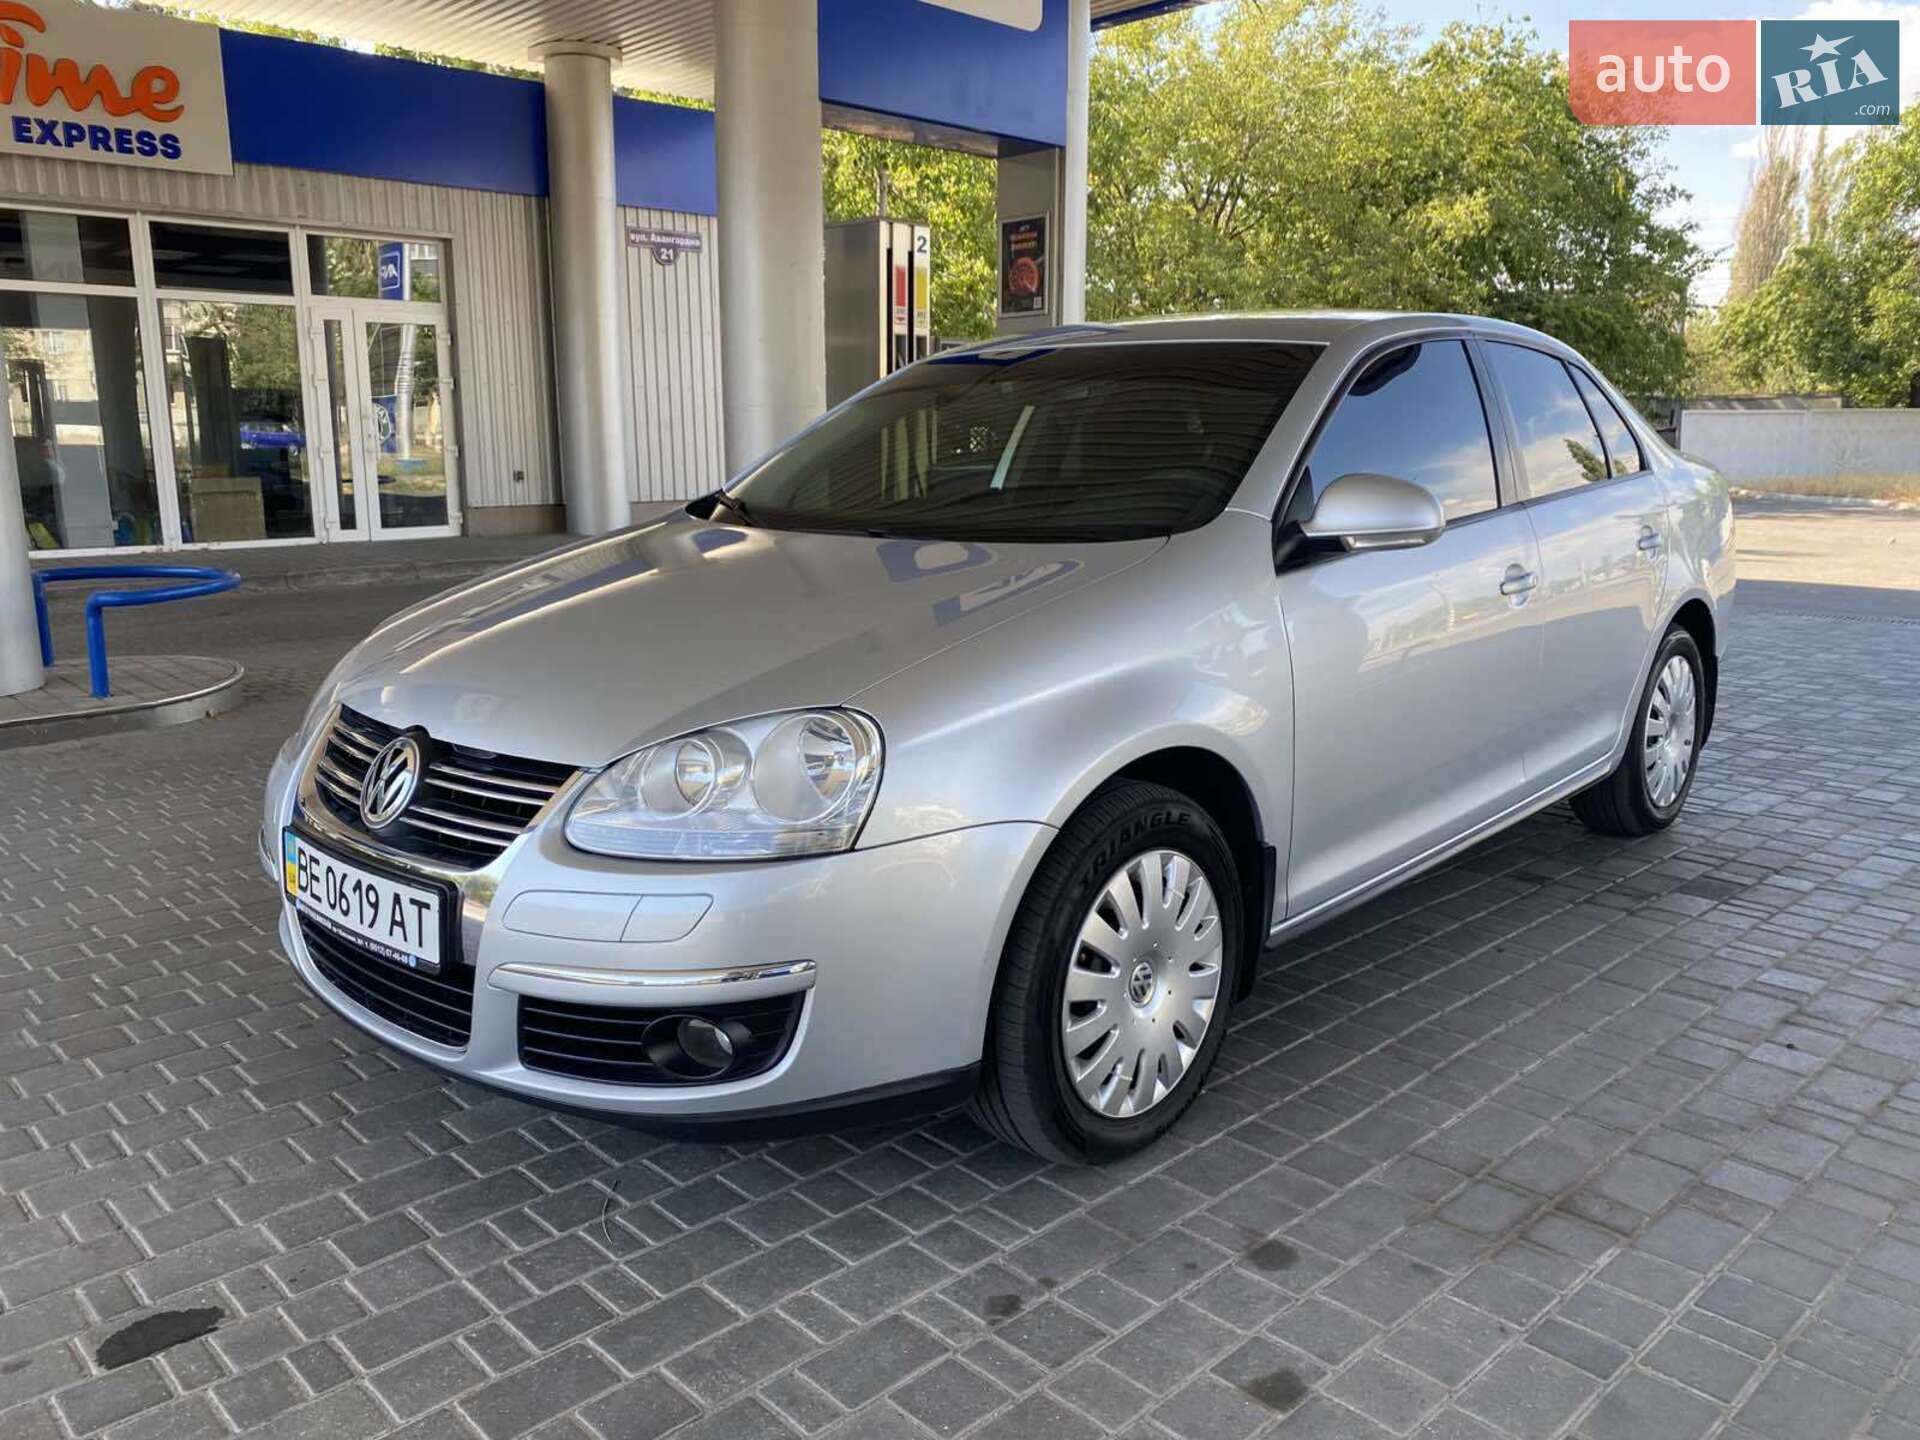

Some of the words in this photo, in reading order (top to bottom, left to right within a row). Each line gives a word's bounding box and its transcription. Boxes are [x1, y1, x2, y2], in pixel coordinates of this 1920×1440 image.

[12, 115, 182, 160] EXPRESS
[660, 248, 674, 260] 21
[916, 235, 928, 254] 2
[1078, 810, 1192, 890] TRIANGLE
[298, 848, 322, 904] BE
[325, 866, 380, 929] 0619
[389, 892, 431, 948] AT
